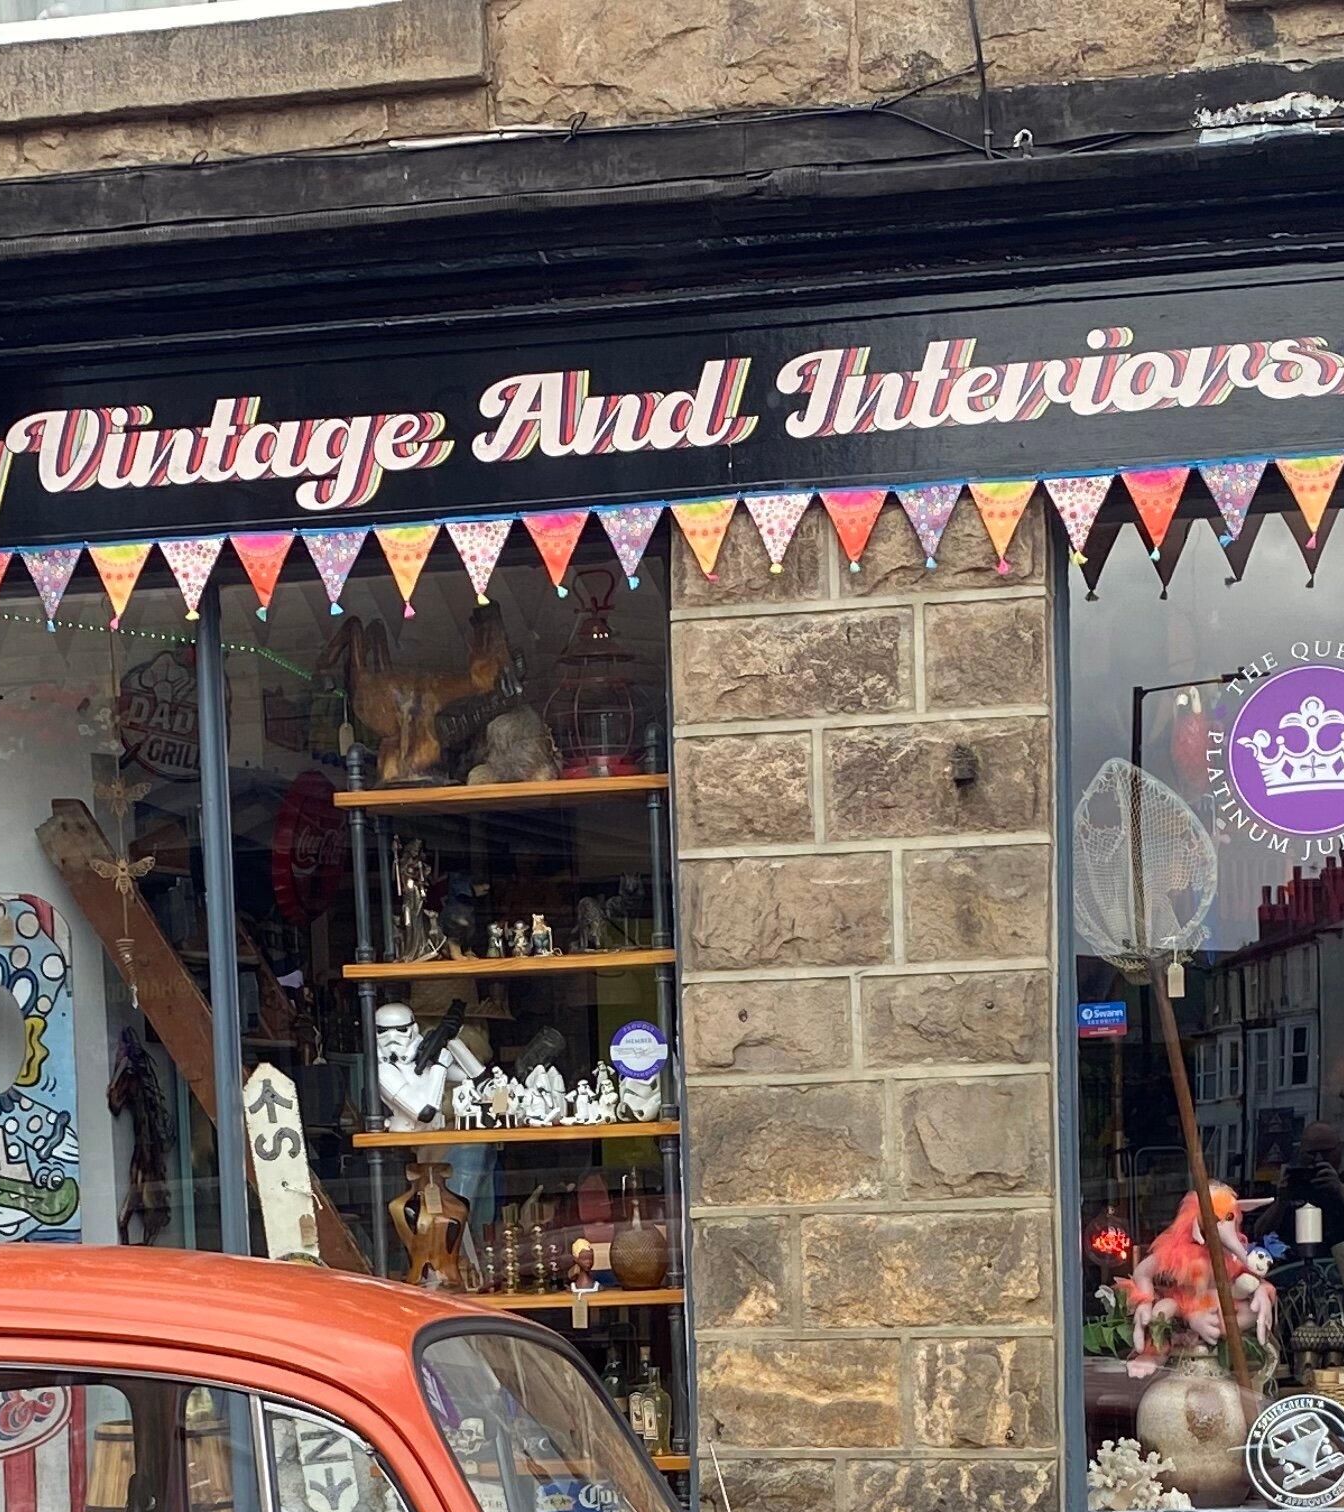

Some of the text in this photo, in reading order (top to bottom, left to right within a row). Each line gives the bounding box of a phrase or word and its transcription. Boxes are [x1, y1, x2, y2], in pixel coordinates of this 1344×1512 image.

[6, 396, 454, 512] Vintage
[470, 356, 758, 464] And
[1226, 652, 1279, 698] THE
[1205, 731, 1290, 854] PLATINUM
[1094, 1009, 1124, 1018] Swann
[1258, 1398, 1314, 1431] SPLITSCREEN
[1284, 1493, 1333, 1507] APPROVED
